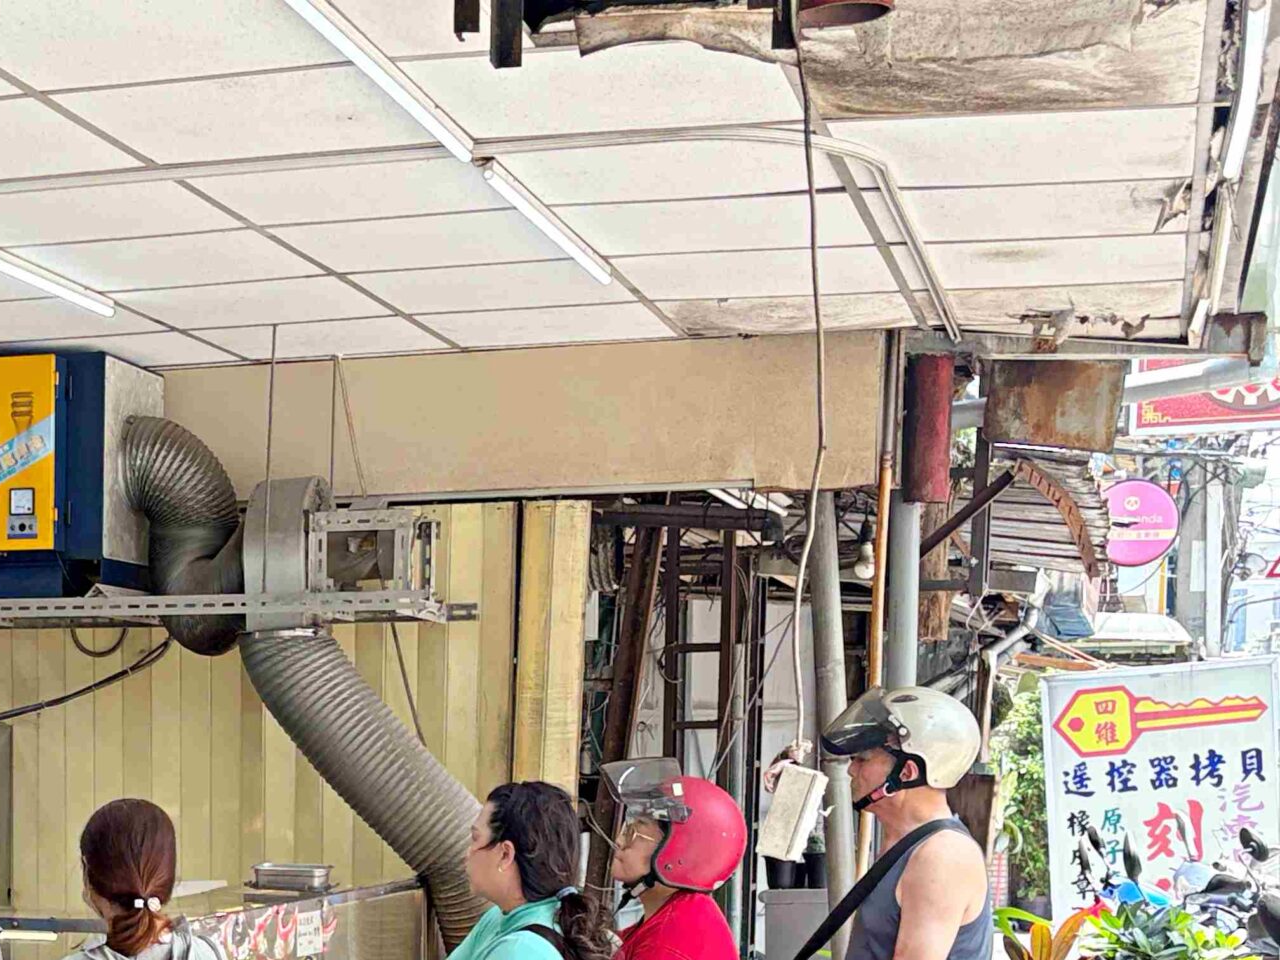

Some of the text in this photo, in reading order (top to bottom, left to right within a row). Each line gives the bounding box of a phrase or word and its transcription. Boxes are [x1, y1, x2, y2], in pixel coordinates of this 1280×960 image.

[1094, 699, 1119, 746] 四維
[1062, 748, 1266, 798] 遙控器拷貝
